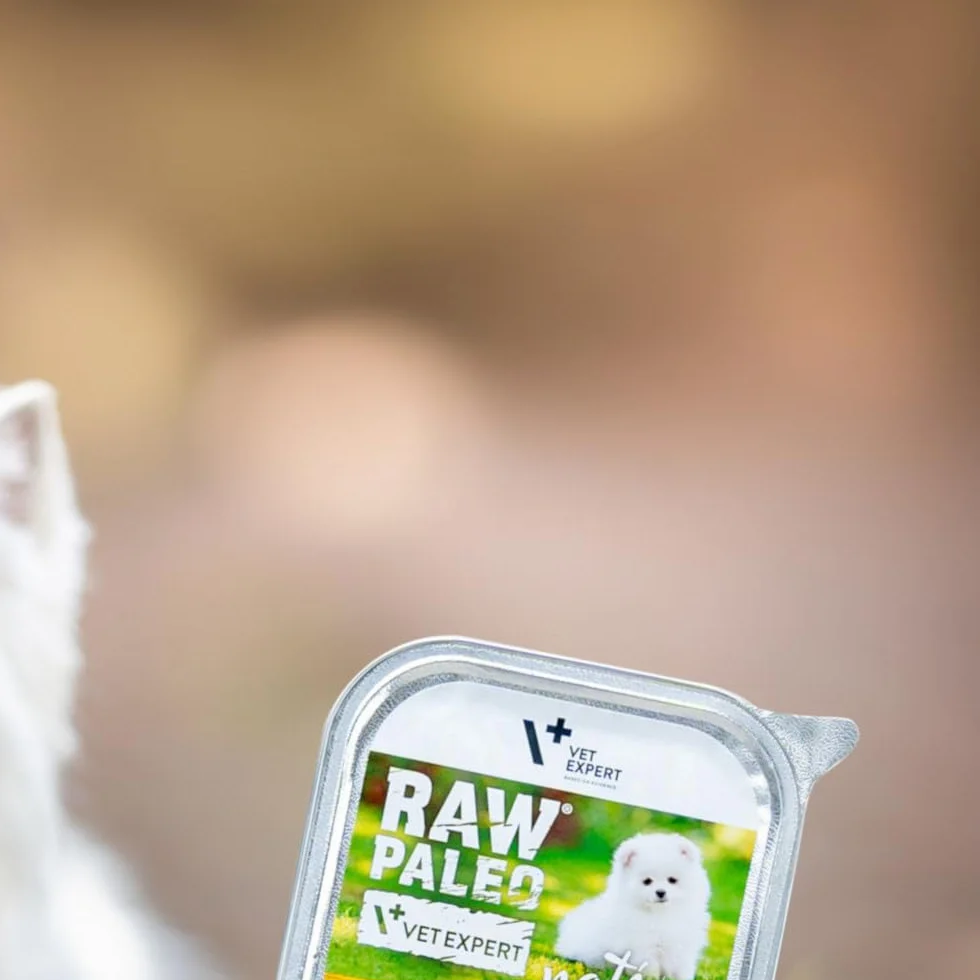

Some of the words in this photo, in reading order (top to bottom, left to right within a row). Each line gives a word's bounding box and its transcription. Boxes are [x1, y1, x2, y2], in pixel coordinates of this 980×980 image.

[566, 760, 623, 781] EXPERT
[569, 745, 597, 761] VET
[380, 766, 562, 861] RAW
[369, 834, 545, 911] PALEO
